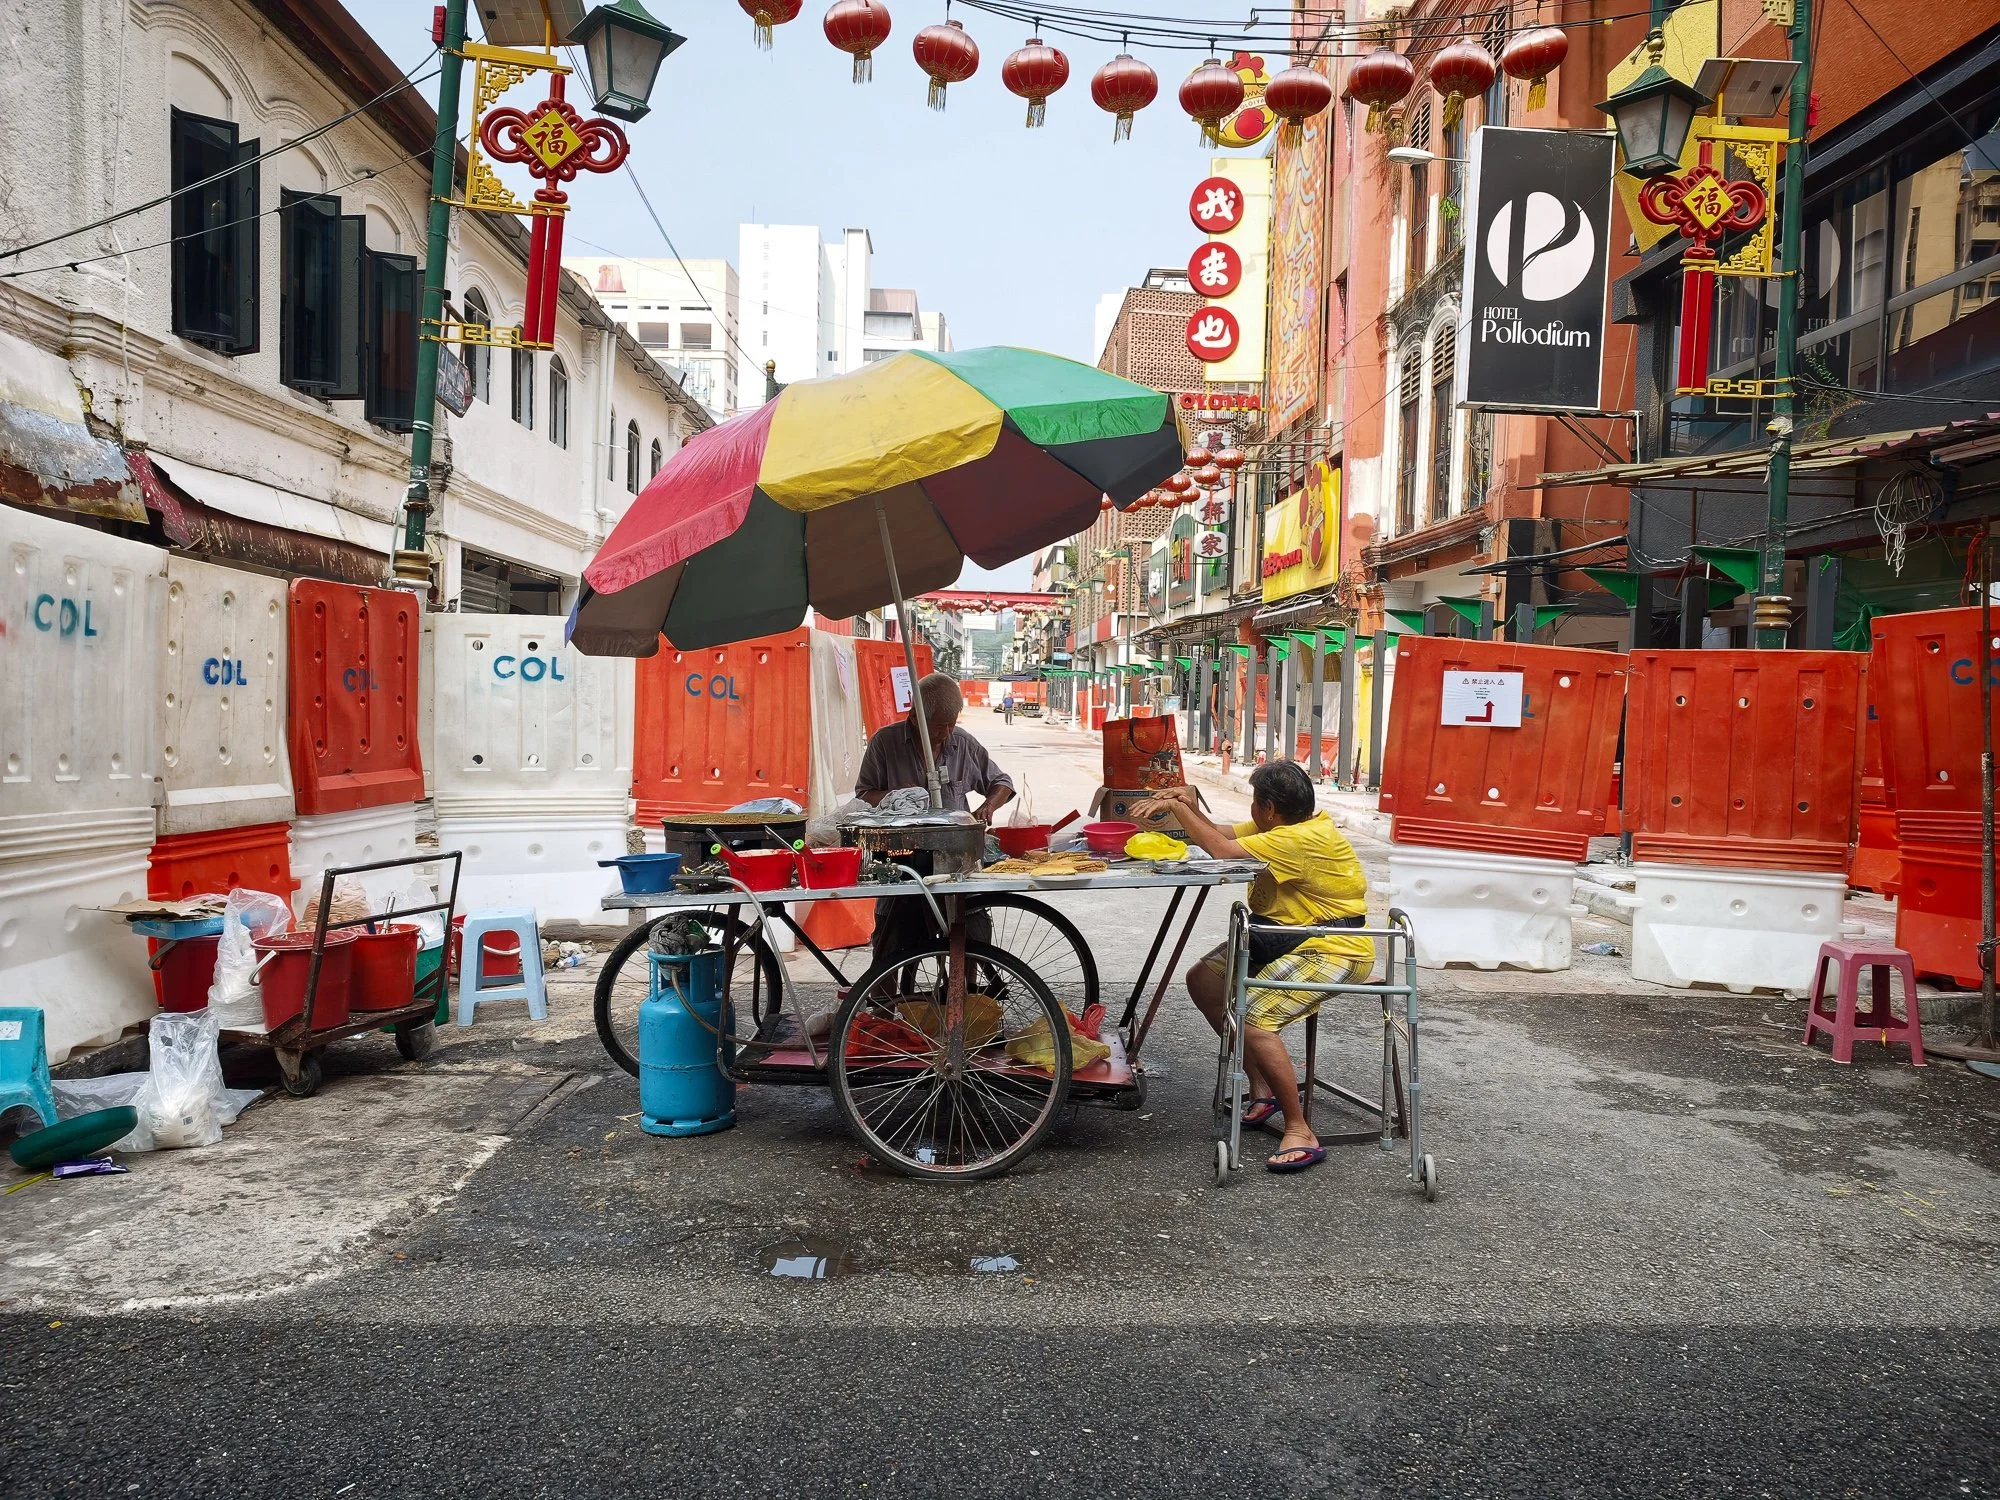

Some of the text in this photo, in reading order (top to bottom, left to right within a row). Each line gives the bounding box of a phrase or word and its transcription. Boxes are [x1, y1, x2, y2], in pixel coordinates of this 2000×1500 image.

[532, 121, 567, 156] 福
[1692, 186, 1721, 217] 福
[1483, 306, 1522, 320] HOTEL
[1481, 319, 1590, 348] Pollodium
[493, 655, 564, 683] COL
[686, 673, 740, 700] COL
